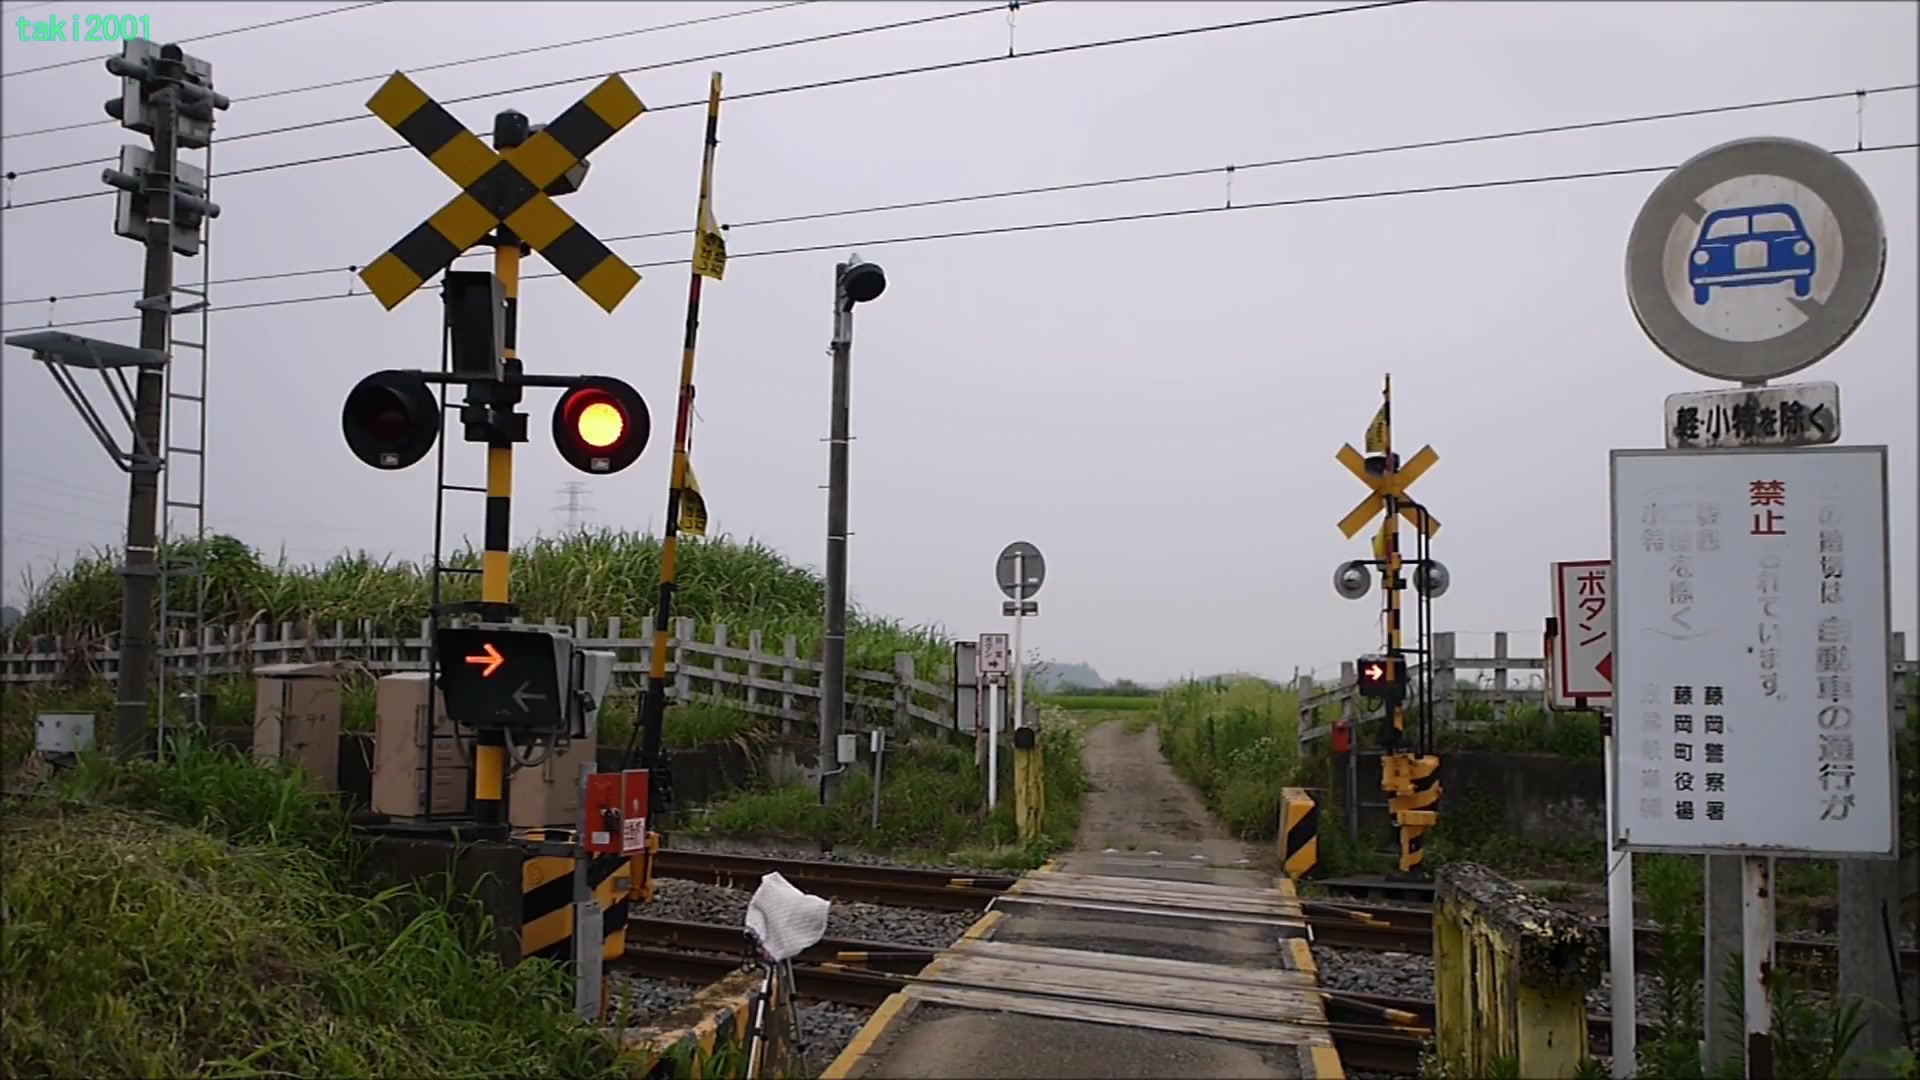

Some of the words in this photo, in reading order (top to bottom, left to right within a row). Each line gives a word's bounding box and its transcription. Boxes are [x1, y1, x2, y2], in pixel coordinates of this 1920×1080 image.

[1749, 479, 1787, 536] 禁止
[1577, 570, 1607, 647] ボタン
[1673, 685, 1695, 821] 藤岡町役場
[1704, 685, 1725, 821] 藤岡警察署
